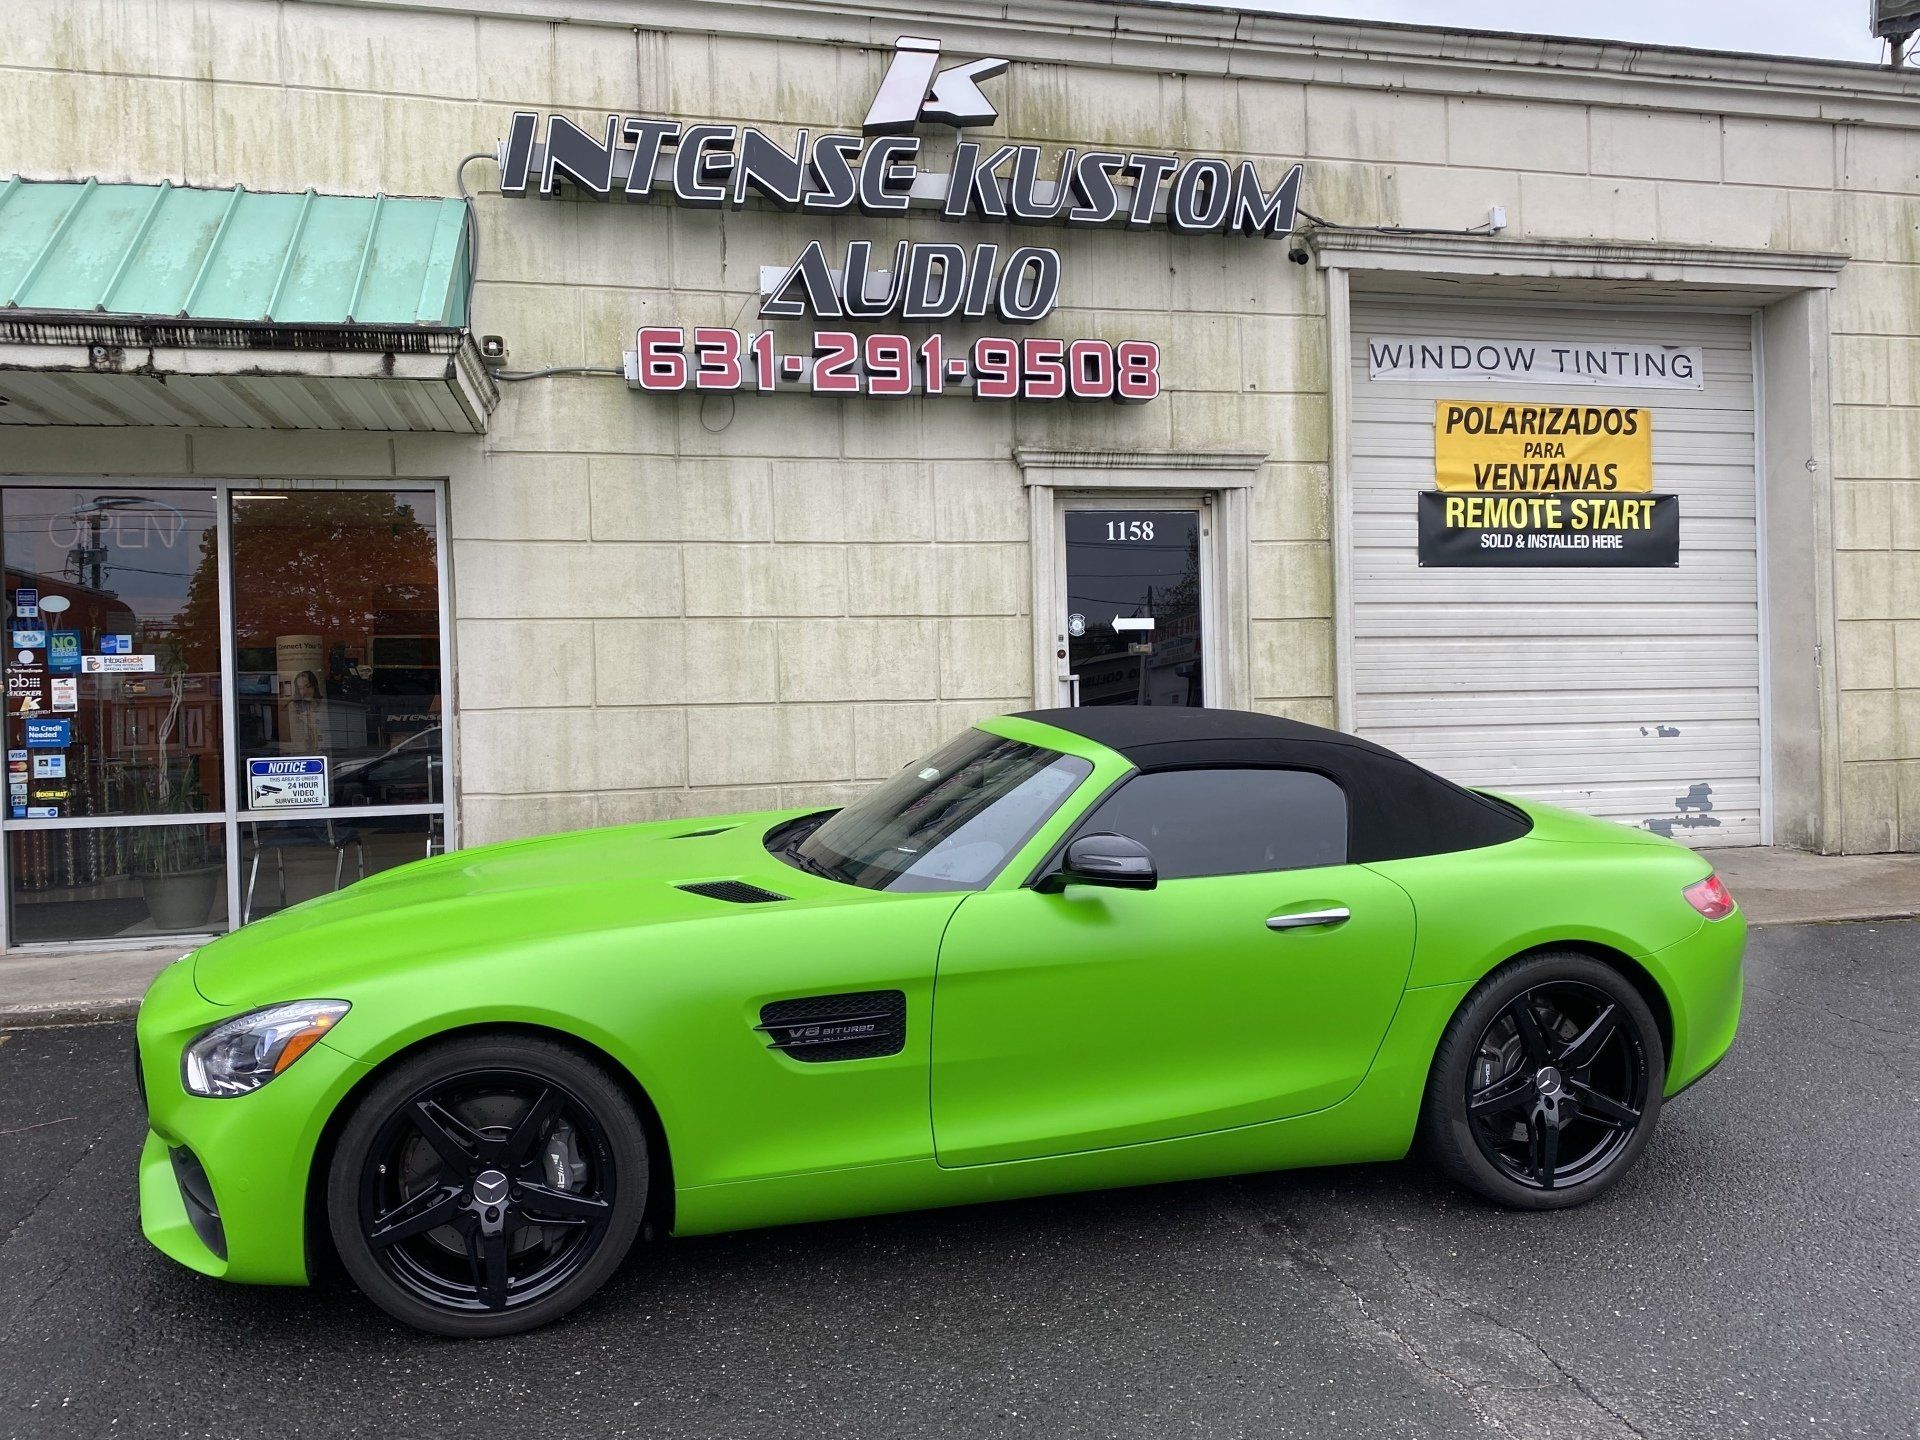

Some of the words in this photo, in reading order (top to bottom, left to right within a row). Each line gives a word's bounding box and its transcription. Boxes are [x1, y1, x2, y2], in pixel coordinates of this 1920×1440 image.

[501, 111, 920, 214] INTENSE
[943, 141, 1304, 237] KUSTOM
[760, 240, 1061, 323] AUDIO
[1370, 344, 1536, 371] WINDOW
[1551, 349, 1694, 379] TINTING
[1446, 406, 1639, 436] POLARIZADOS
[1523, 442, 1565, 459] PARA
[1474, 463, 1619, 491] VENTANAS
[1446, 497, 1563, 530] REMOTE
[1570, 499, 1657, 531] START
[49, 511, 175, 548] OPEN
[1106, 521, 1155, 541] 1158
[1480, 533, 1514, 549] SOLD
[1515, 534, 1525, 548] &
[1527, 534, 1590, 549] INSTALLED
[1592, 535, 1623, 549] HERE
[51, 636, 77, 648] NO
[268, 761, 307, 774] NOTICE
[287, 782, 297, 790] 24
[298, 781, 319, 789] HOUR
[292, 789, 315, 797] VIDEO
[274, 796, 319, 804] SURVEILLANCE
[789, 1026, 820, 1038] V8
[822, 1024, 875, 1035] BITURBO
